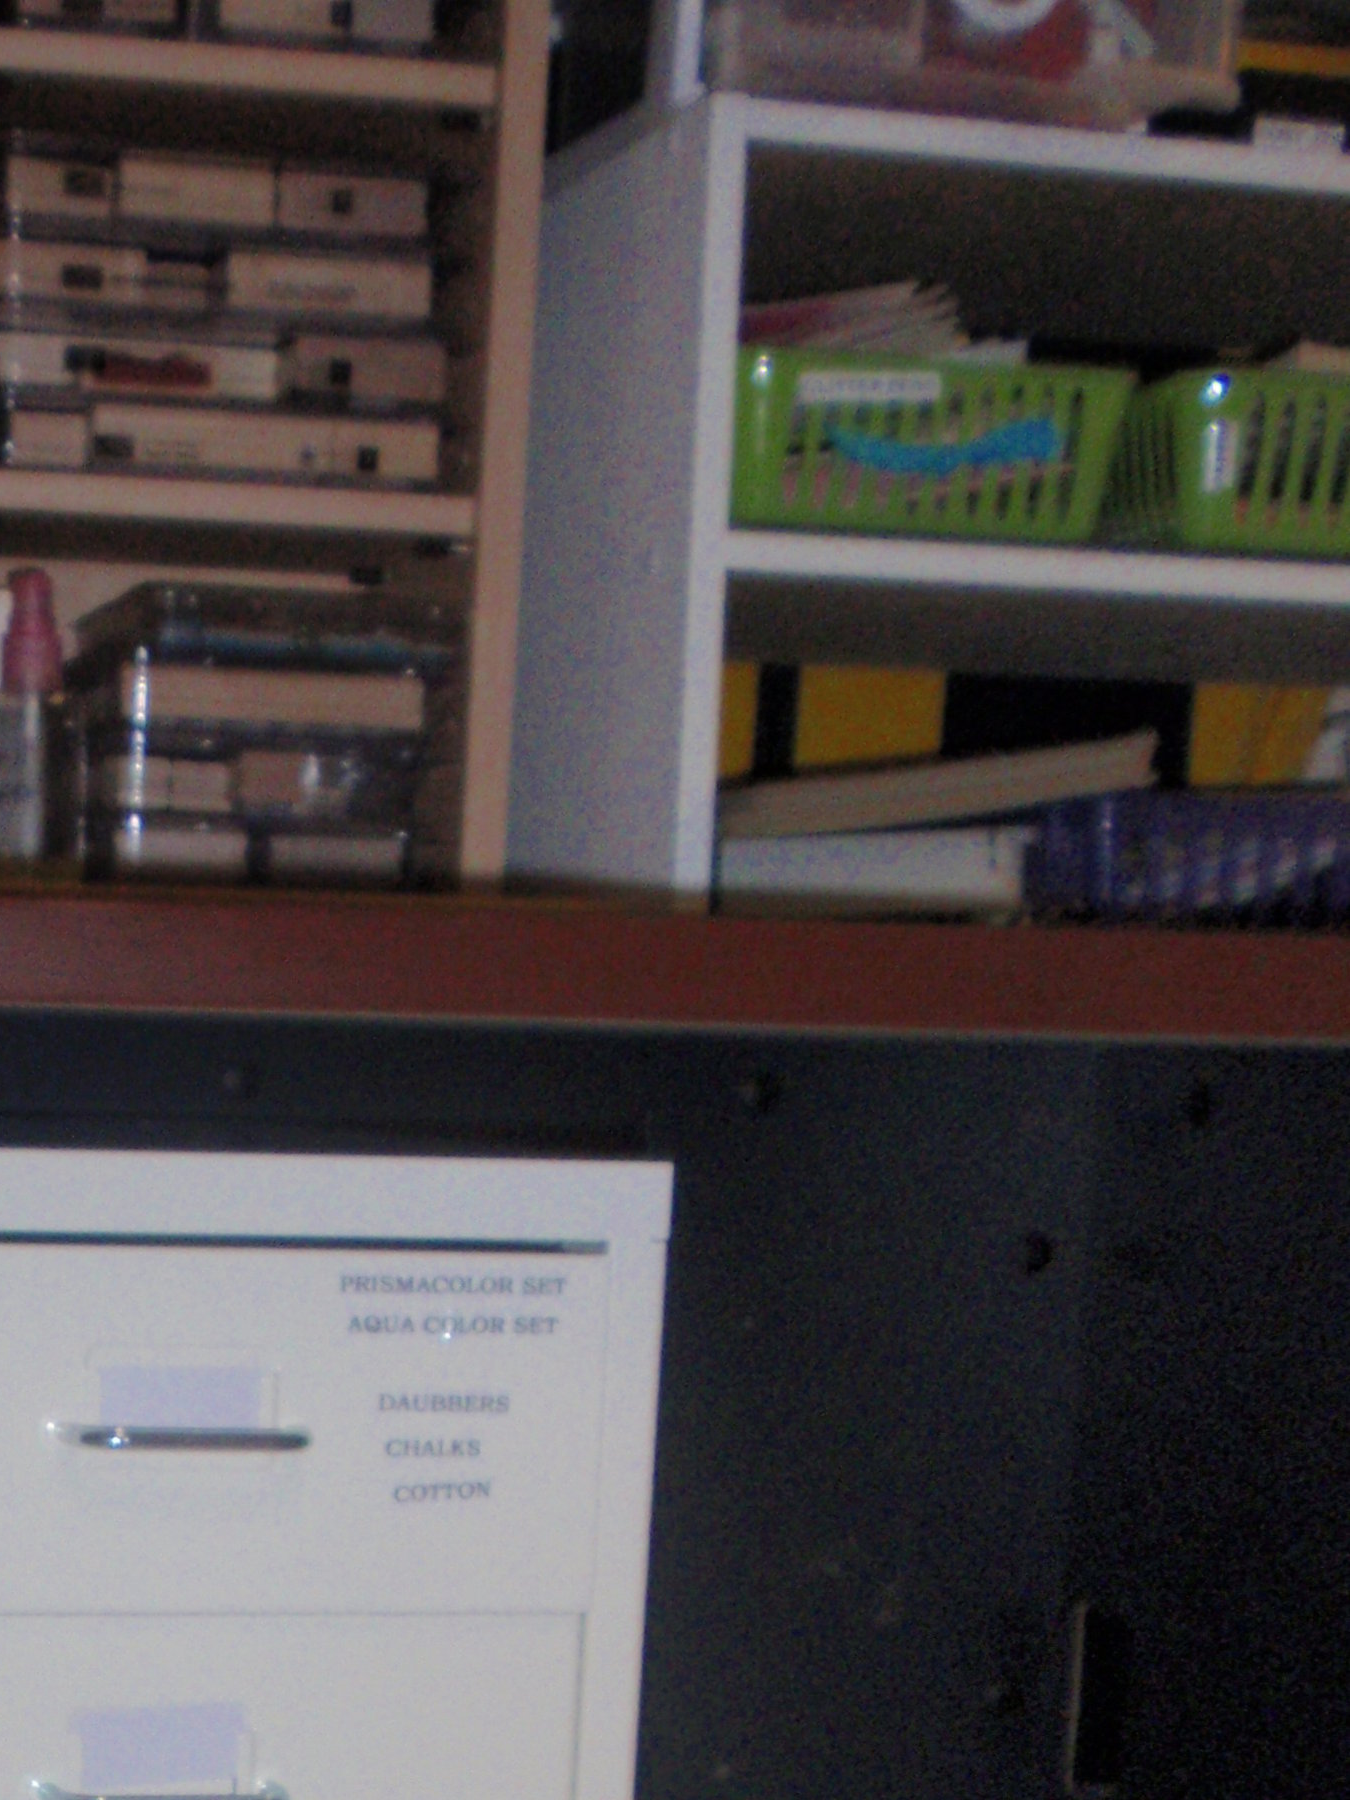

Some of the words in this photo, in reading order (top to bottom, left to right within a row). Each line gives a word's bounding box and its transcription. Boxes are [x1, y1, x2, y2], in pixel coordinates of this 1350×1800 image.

[340, 1274, 514, 1295] PRISMACOLOR
[522, 1276, 567, 1295] SET
[348, 1314, 415, 1334] AQUA
[423, 1314, 505, 1335] COLOR
[513, 1316, 559, 1335] SET
[378, 1393, 510, 1414] DAUBBERS
[384, 1438, 482, 1458] CHALKS
[394, 1481, 491, 1504] COTTON
